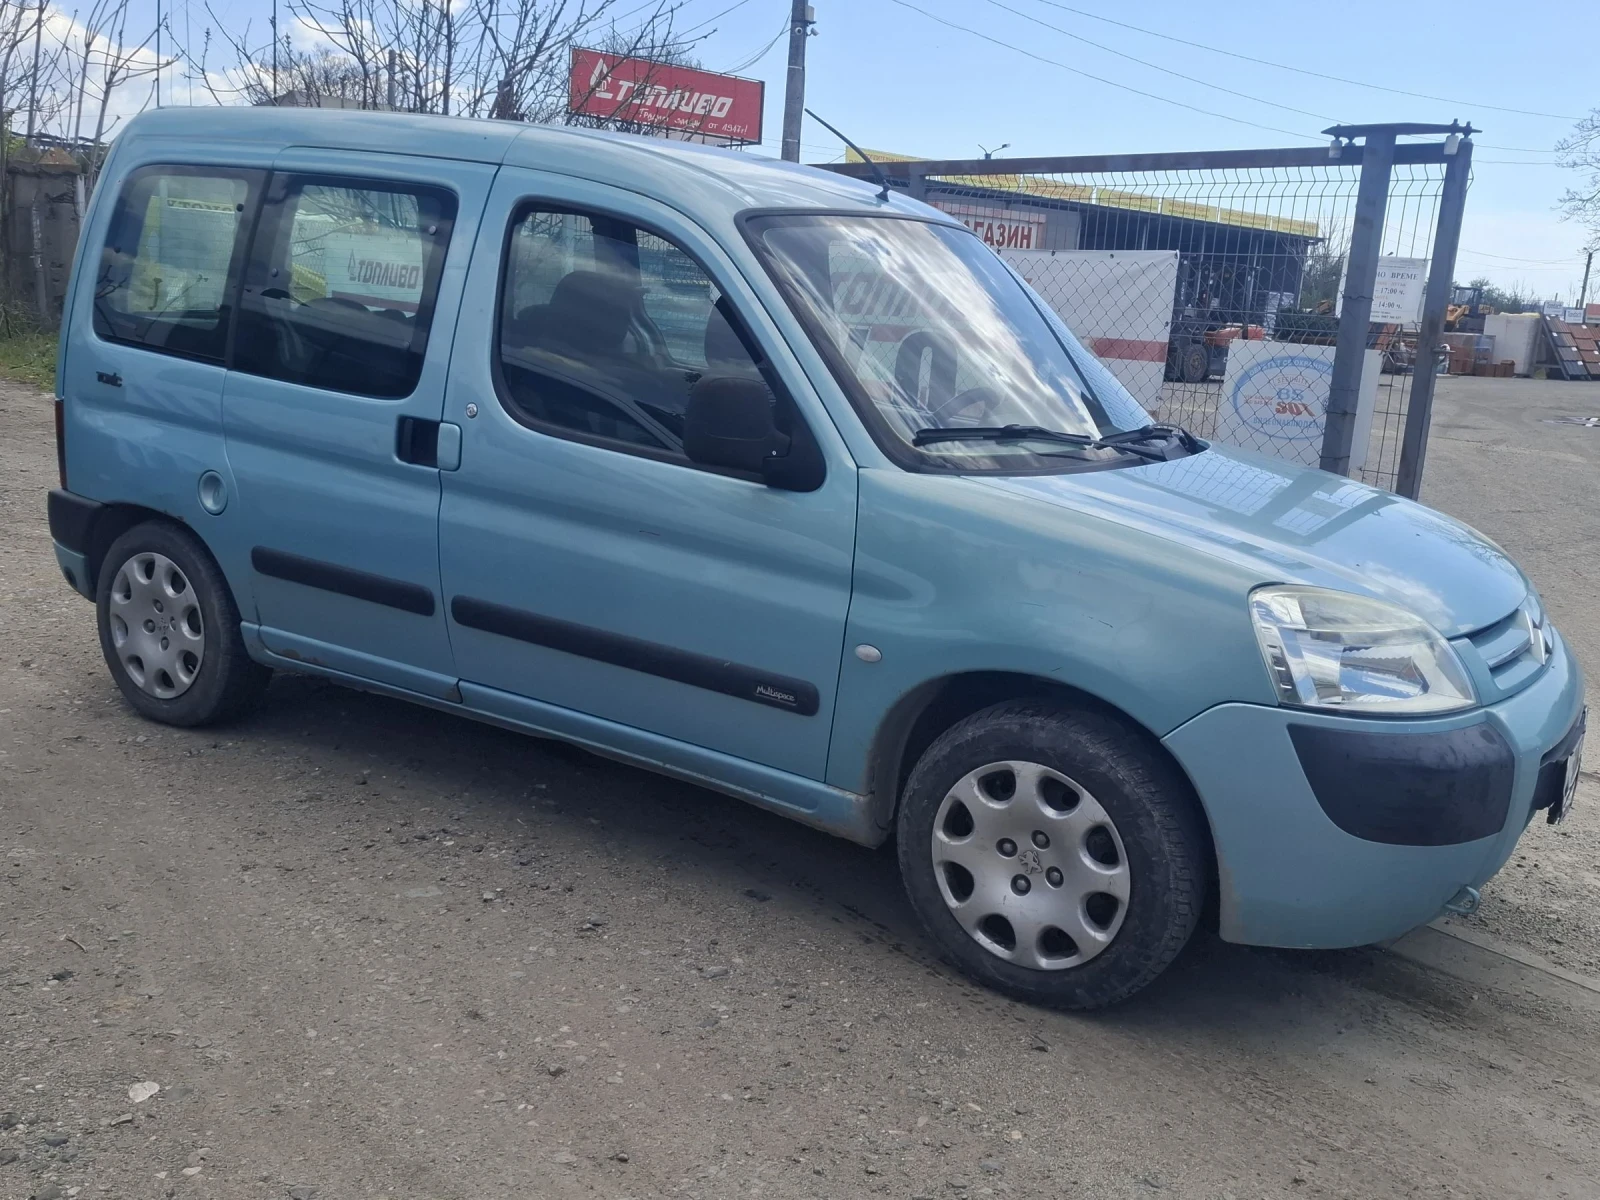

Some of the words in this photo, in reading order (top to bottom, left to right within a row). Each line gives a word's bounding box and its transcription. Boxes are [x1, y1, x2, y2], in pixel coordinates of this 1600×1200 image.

[708, 121, 718, 129] от
[358, 260, 420, 289] ТОПЛИВО
[1391, 272, 1418, 280] ВРЕМЕ
[756, 685, 796, 702] Multispace
